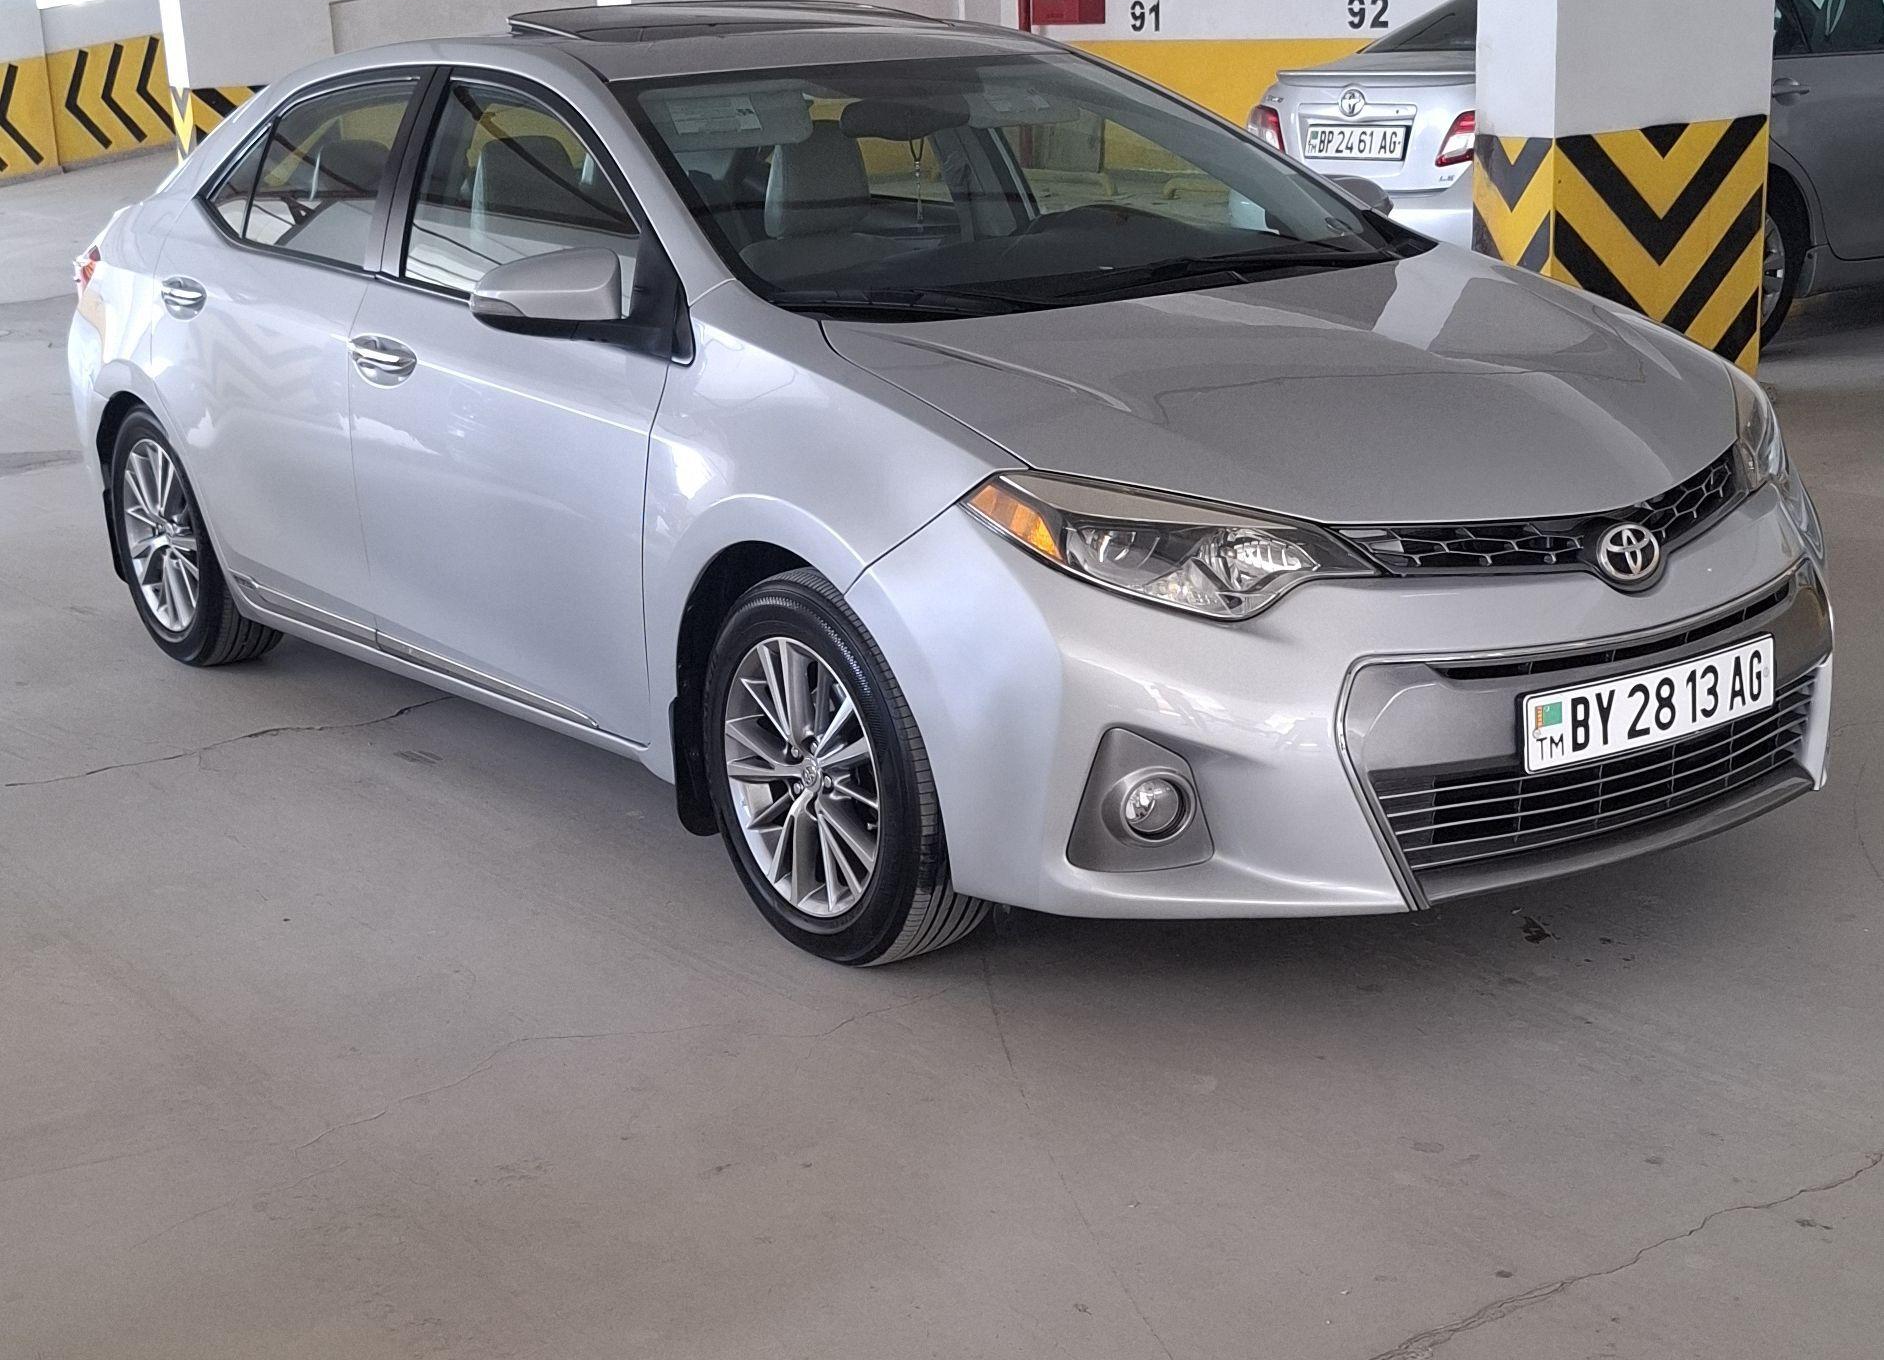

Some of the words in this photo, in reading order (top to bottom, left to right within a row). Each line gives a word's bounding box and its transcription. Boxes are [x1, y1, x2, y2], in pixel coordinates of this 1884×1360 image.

[1129, 0, 1160, 32] 91
[1318, 131, 1334, 153] BP
[1335, 130, 1354, 153] 24
[1357, 131, 1375, 153] 61
[1378, 131, 1397, 153] AG
[1571, 689, 1616, 752] BY
[1627, 677, 1677, 740] 28
[1686, 664, 1719, 723] 13
[1729, 650, 1763, 711] AG
[1536, 733, 1565, 761] TM
